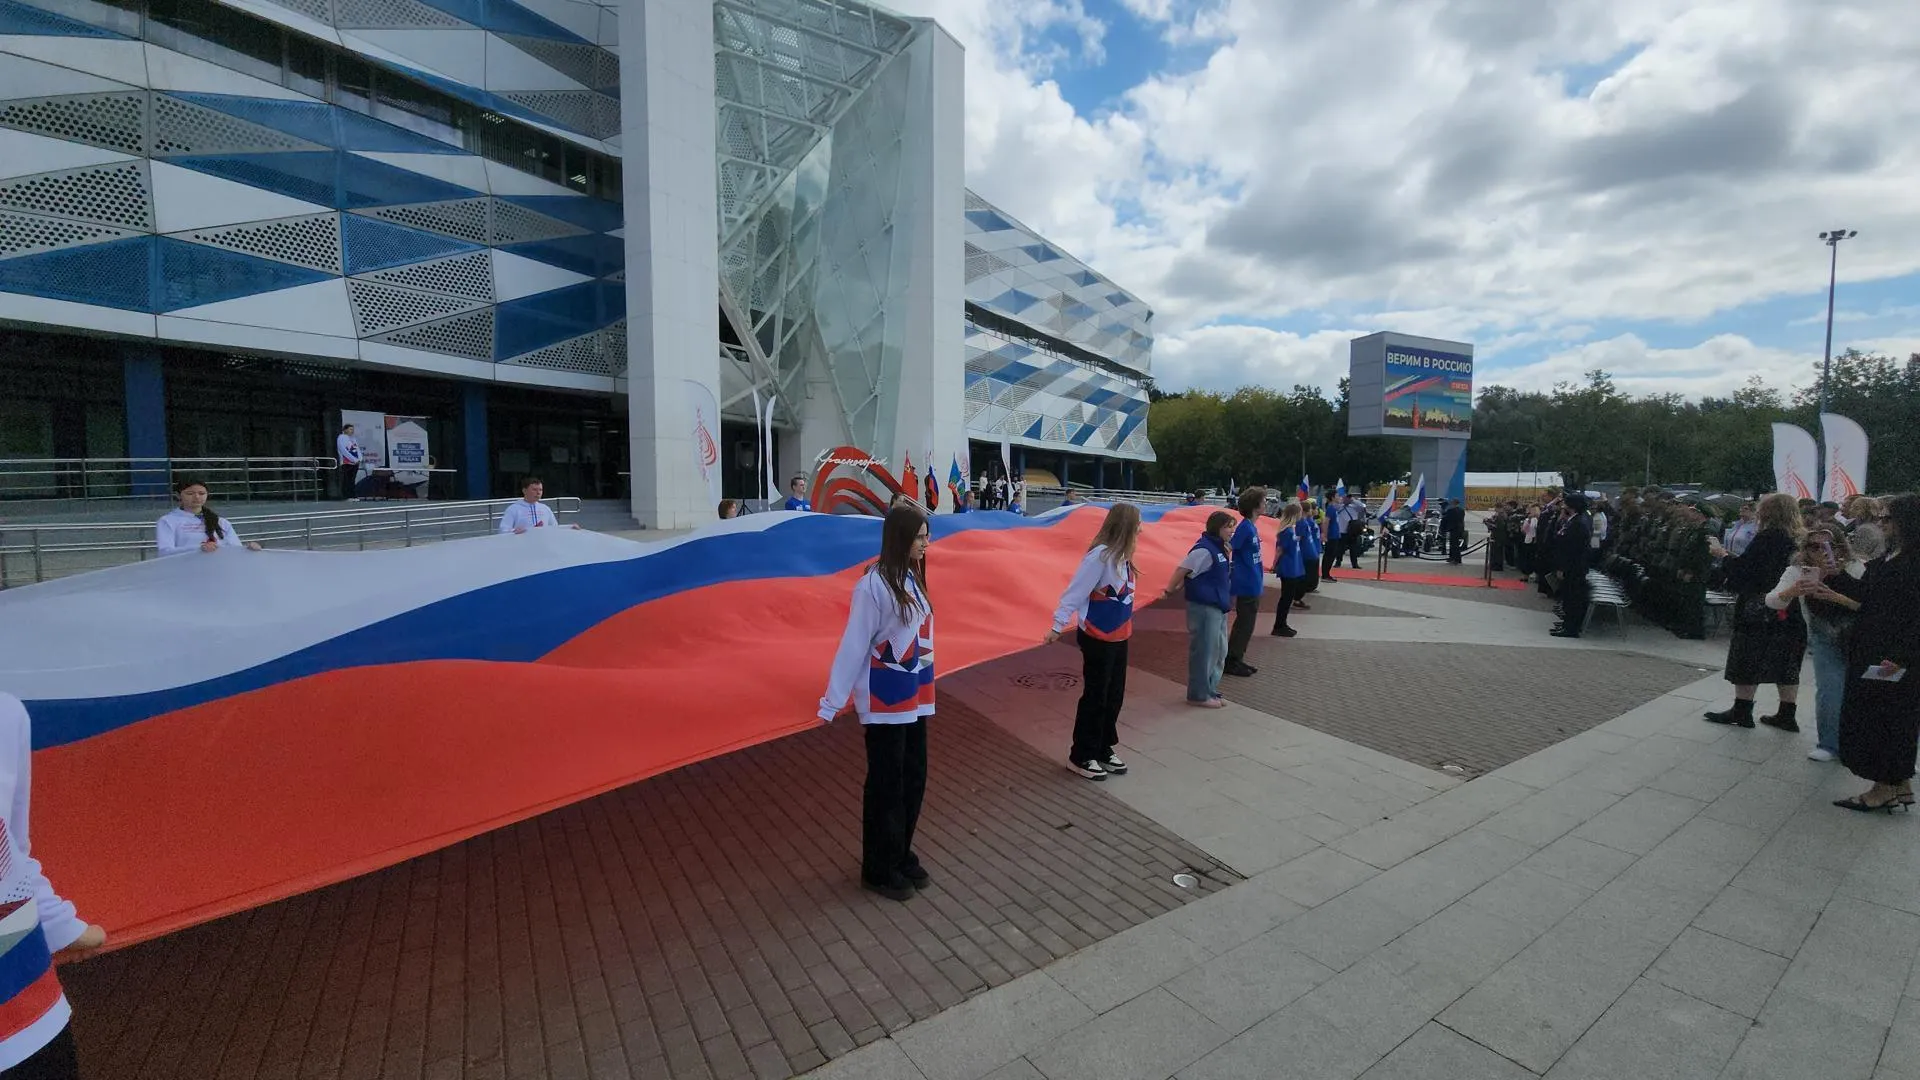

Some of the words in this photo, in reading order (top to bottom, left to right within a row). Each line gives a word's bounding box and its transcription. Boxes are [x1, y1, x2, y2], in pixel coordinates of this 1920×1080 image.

[1386, 352, 1421, 367] ВЕРИМ
[1423, 358, 1430, 368] В
[1432, 359, 1472, 373] РОССИЮ
